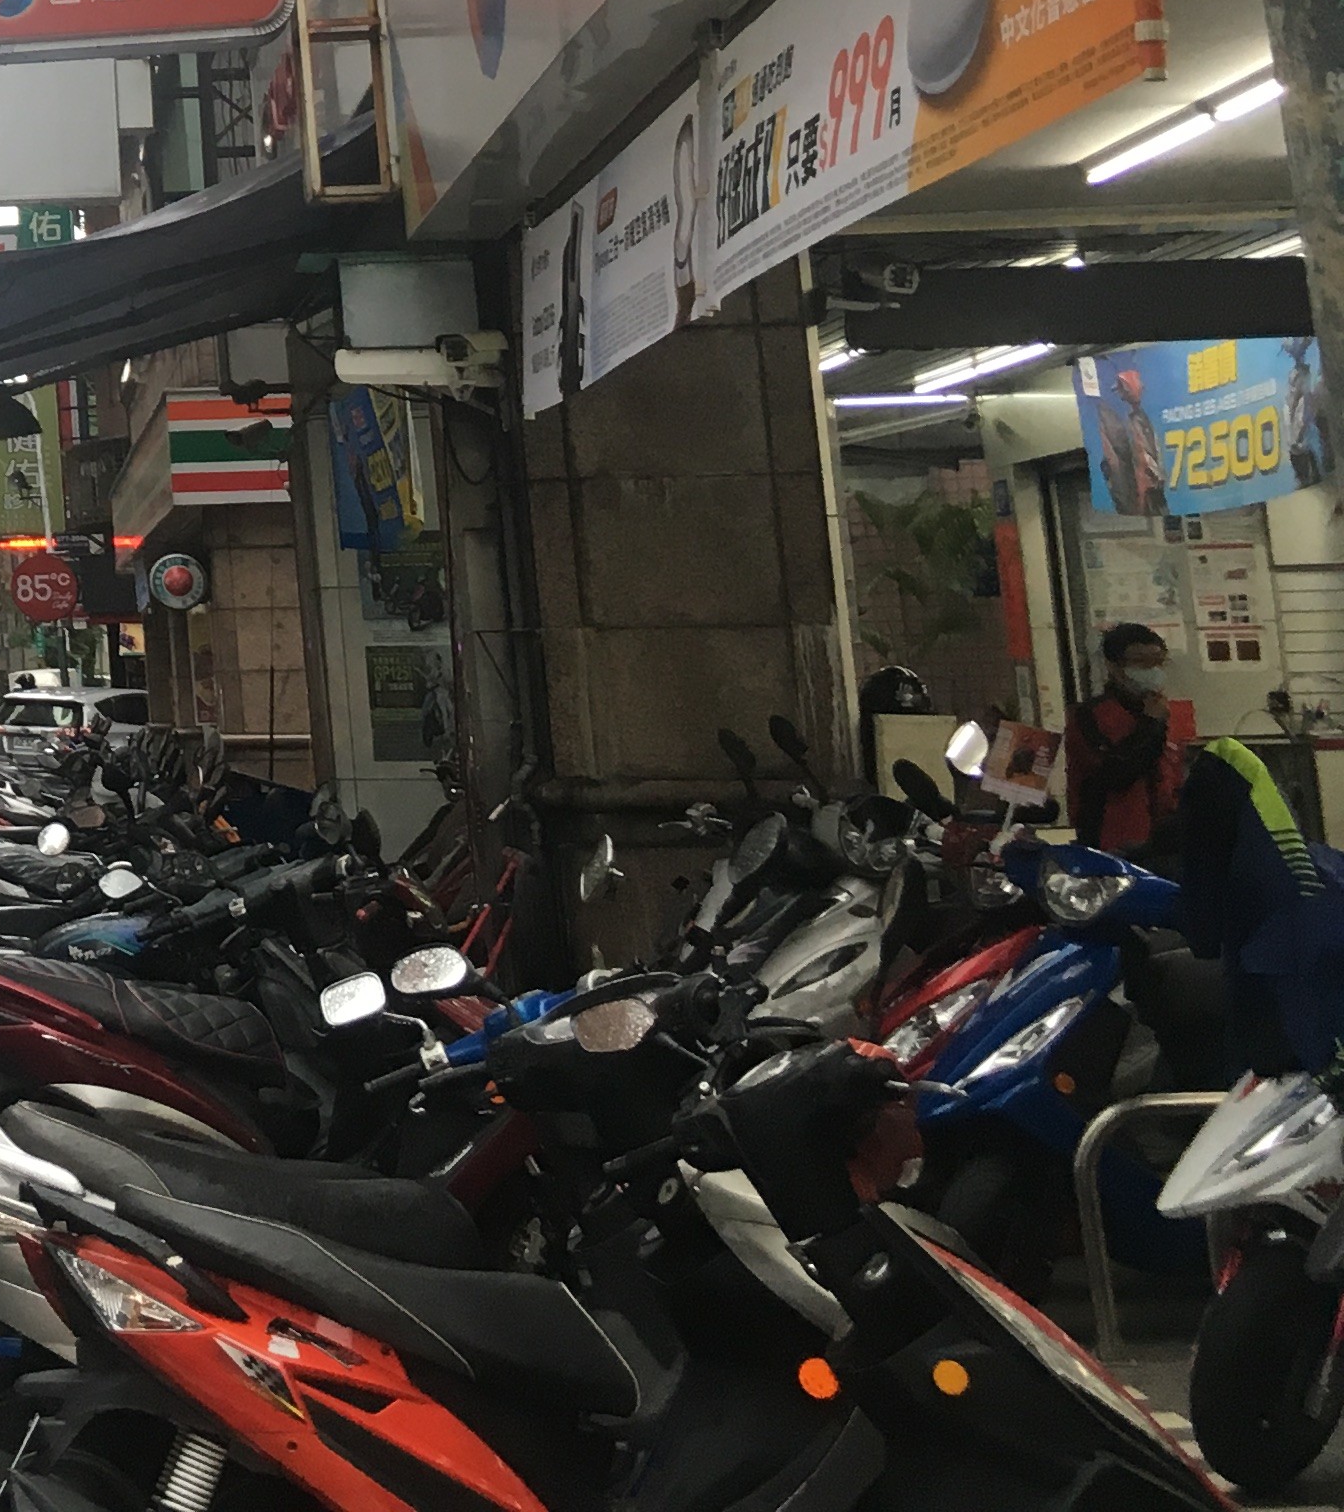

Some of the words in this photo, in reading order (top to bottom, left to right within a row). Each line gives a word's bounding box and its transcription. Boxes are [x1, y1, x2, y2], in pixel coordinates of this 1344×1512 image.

[819, 14, 895, 173] $999
[28, 210, 62, 243] 佑
[1164, 405, 1282, 491] 72500
